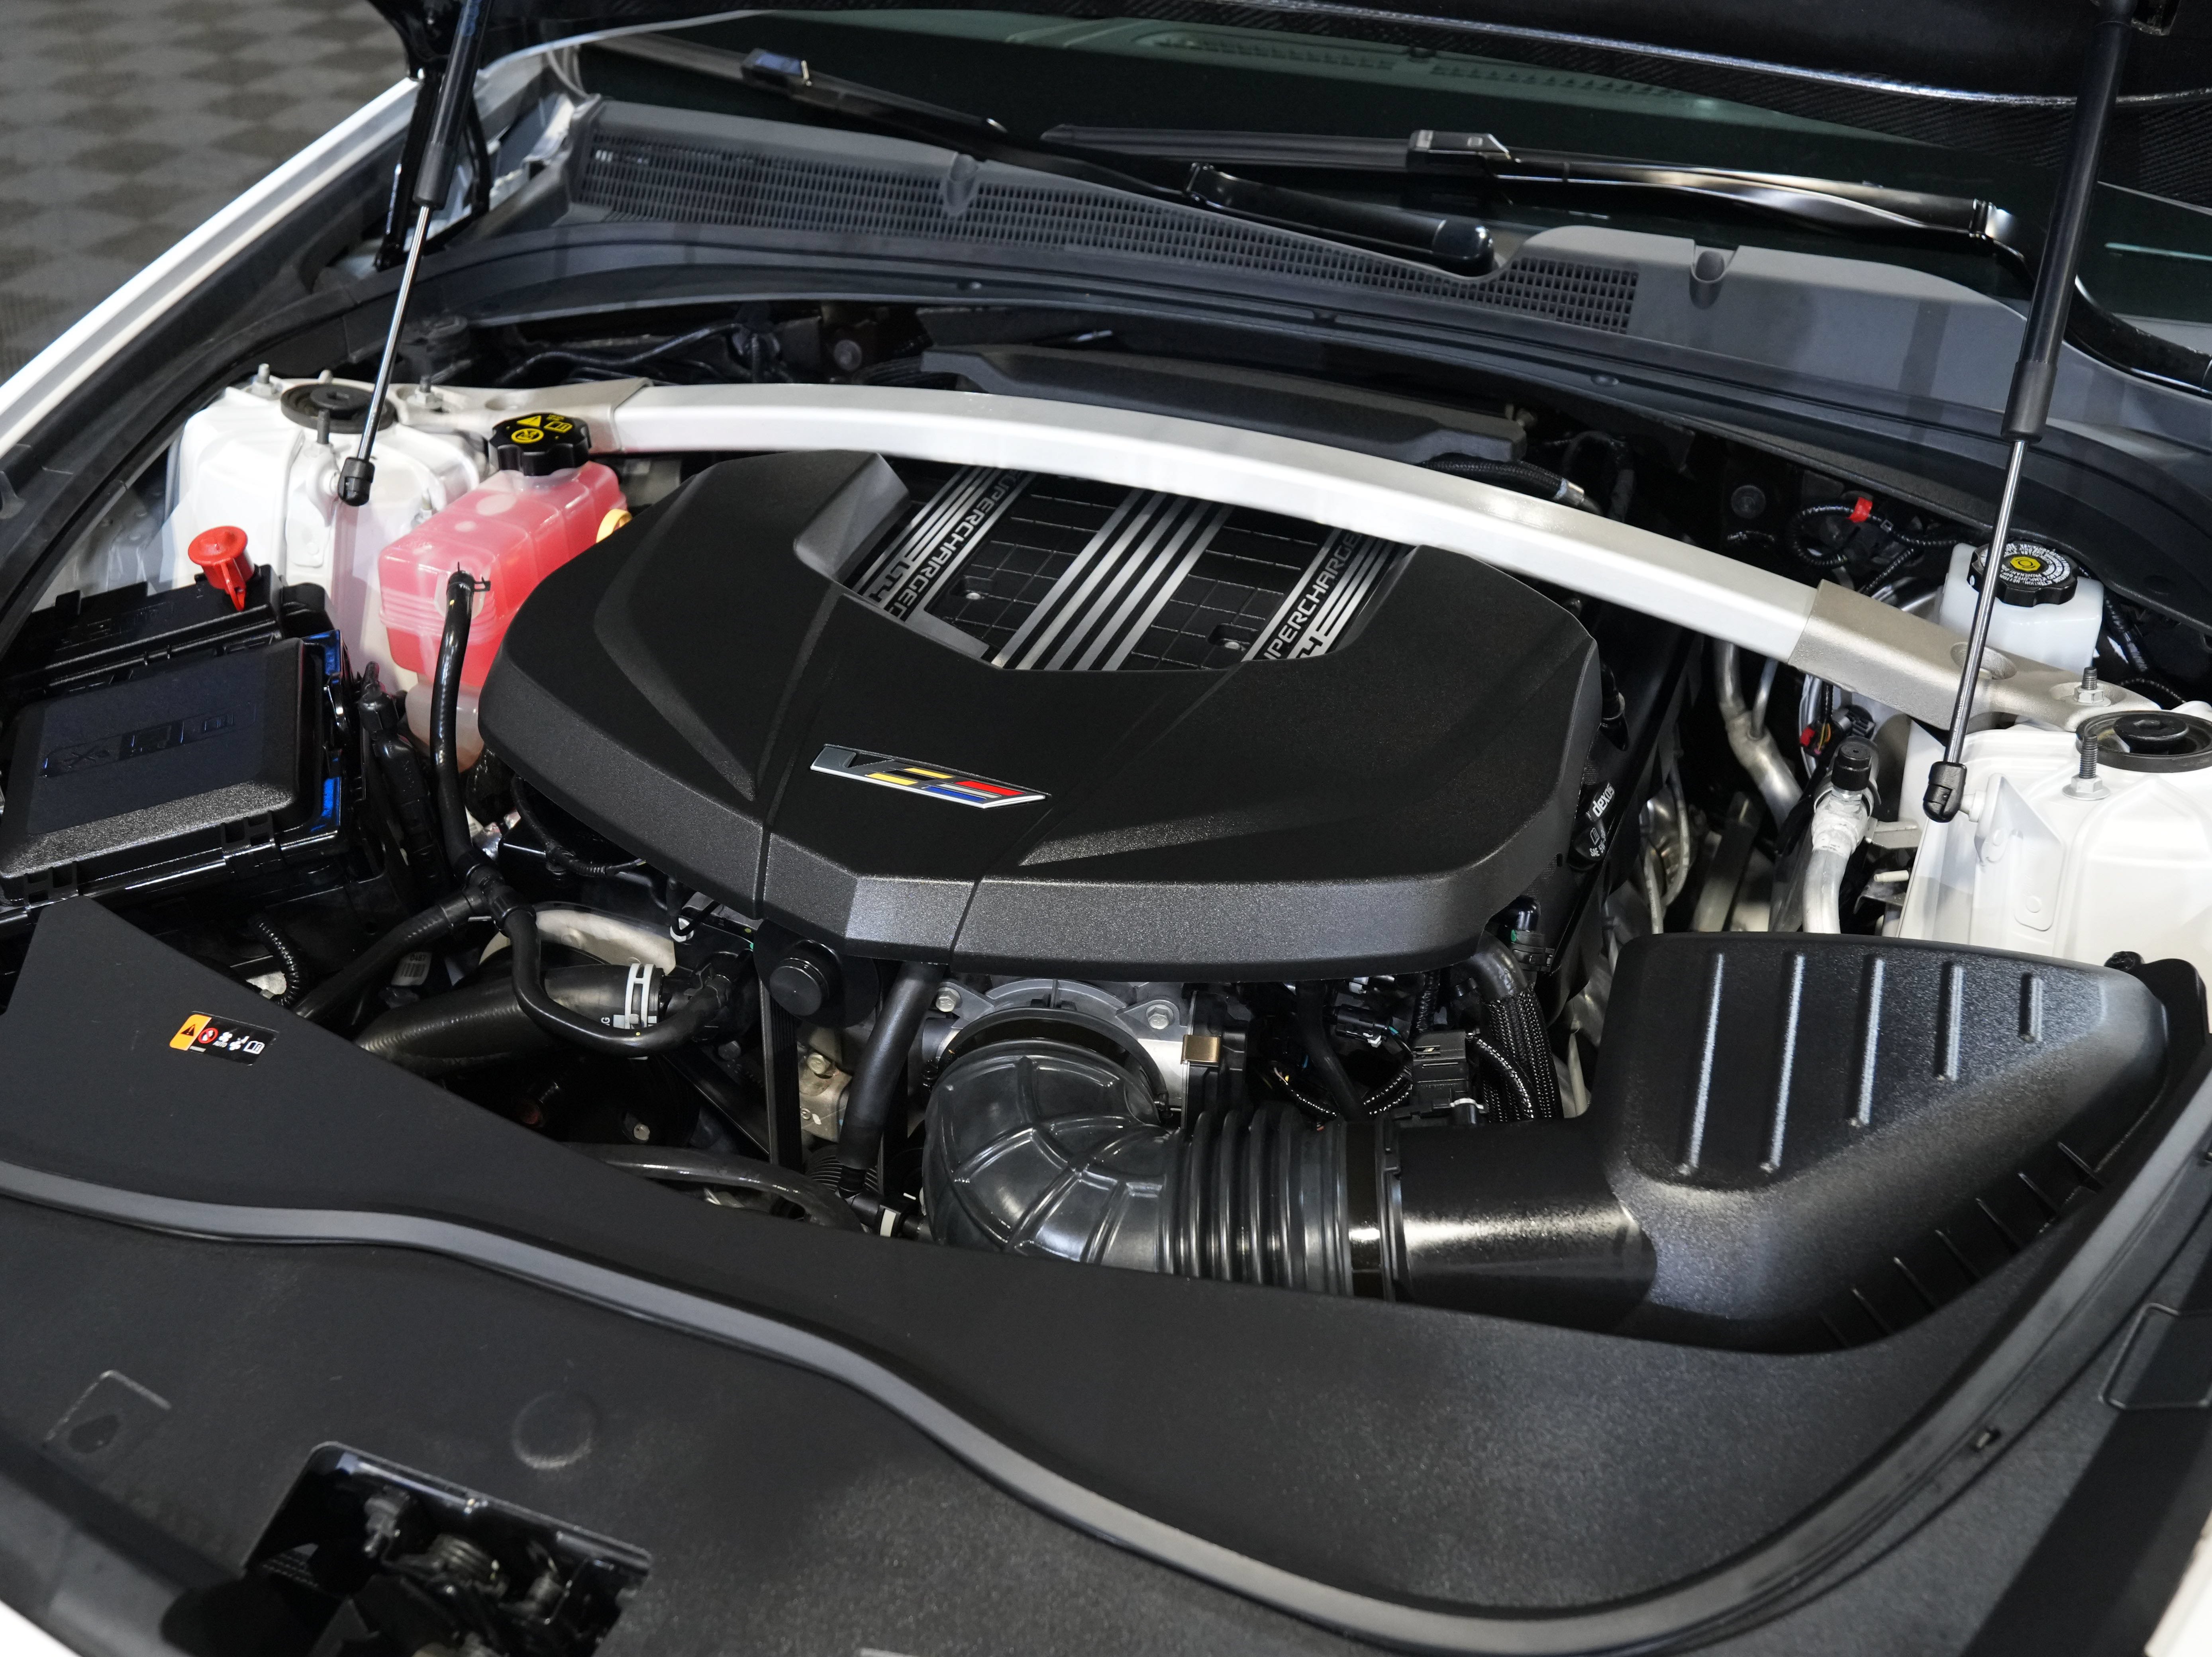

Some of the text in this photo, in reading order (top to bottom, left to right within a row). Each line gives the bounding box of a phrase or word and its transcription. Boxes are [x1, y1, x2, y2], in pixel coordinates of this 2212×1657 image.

[869, 560, 911, 602] LT4
[1592, 782, 1614, 817] dexos
[1589, 848, 1600, 856] SAE
